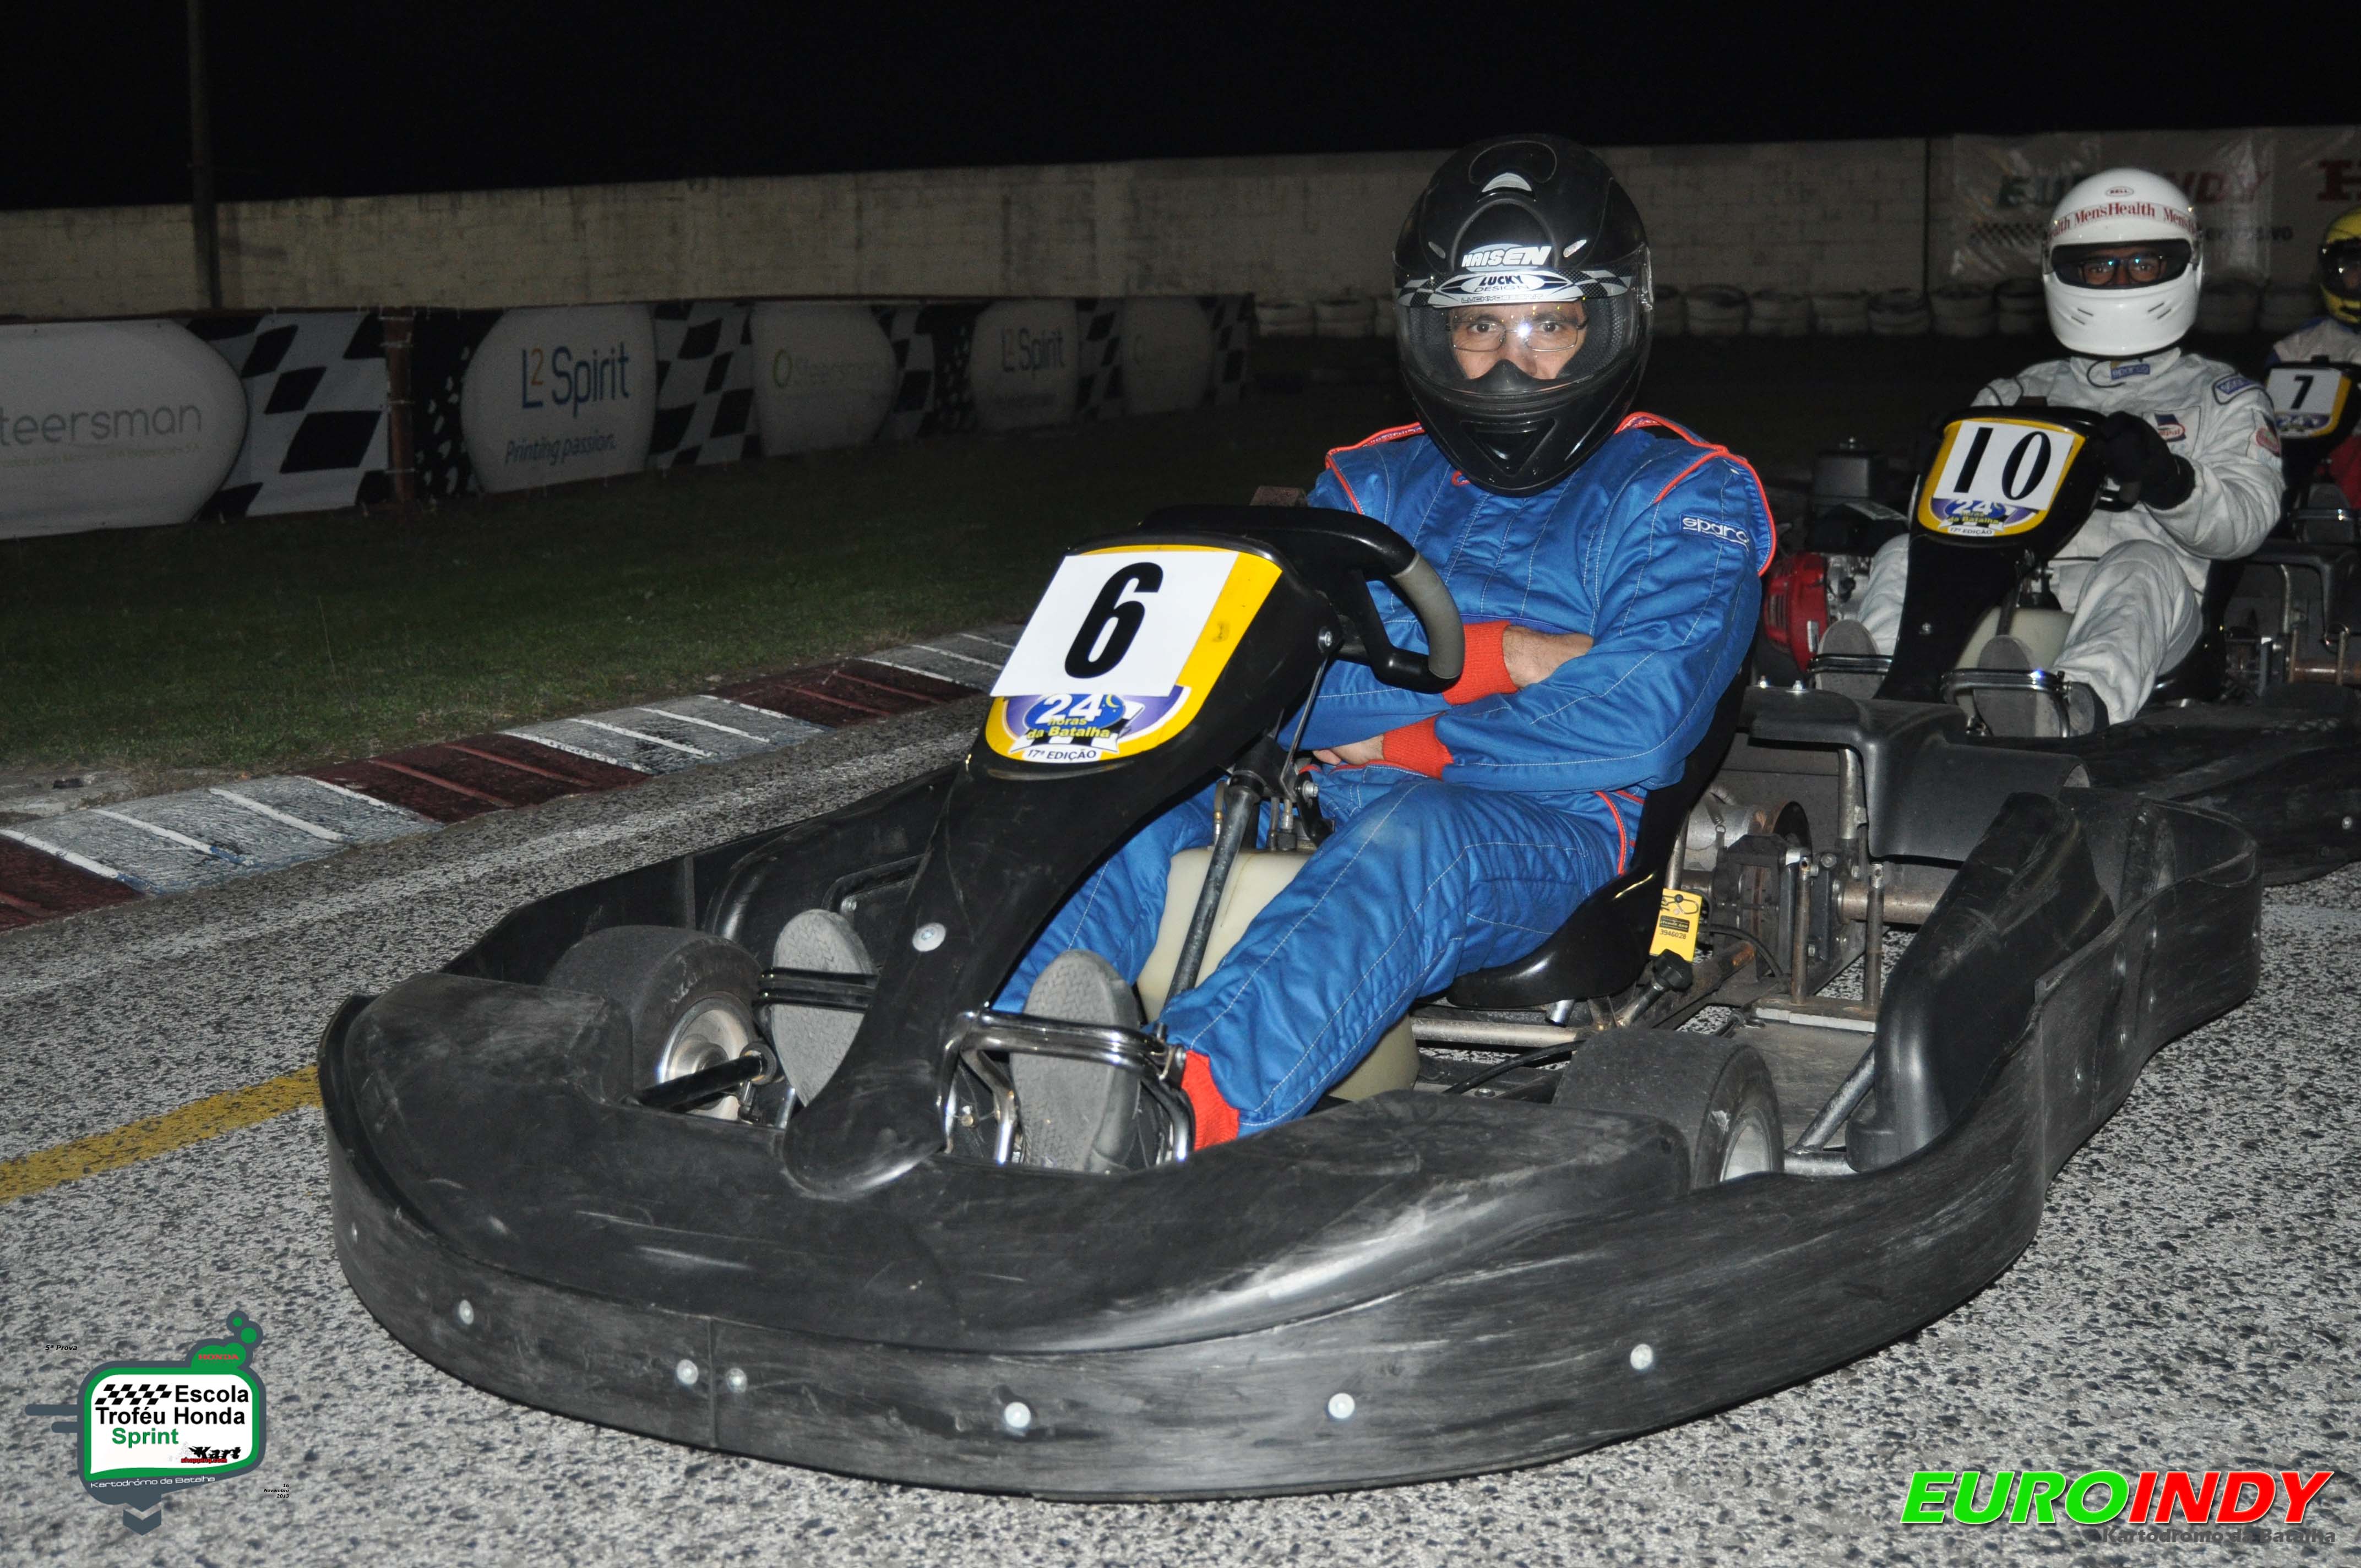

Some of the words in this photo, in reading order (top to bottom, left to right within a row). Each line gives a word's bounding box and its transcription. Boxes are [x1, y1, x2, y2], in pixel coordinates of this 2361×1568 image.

[1479, 275, 1524, 286] LUCKY
[2290, 375, 2314, 410] 7
[0, 404, 202, 447] teersman
[504, 435, 561, 465] Printing
[1954, 427, 2052, 500] 10
[1952, 499, 1993, 515] 24
[1961, 516, 2000, 524] Batalha
[1064, 562, 1164, 679] 6
[1035, 693, 1103, 724] 24
[1047, 717, 1088, 726] horas
[1026, 729, 1045, 739] da
[1048, 726, 1110, 738] Batalha
[1046, 748, 1097, 761] EDIÇÃO
[1660, 929, 1687, 939] 3946028
